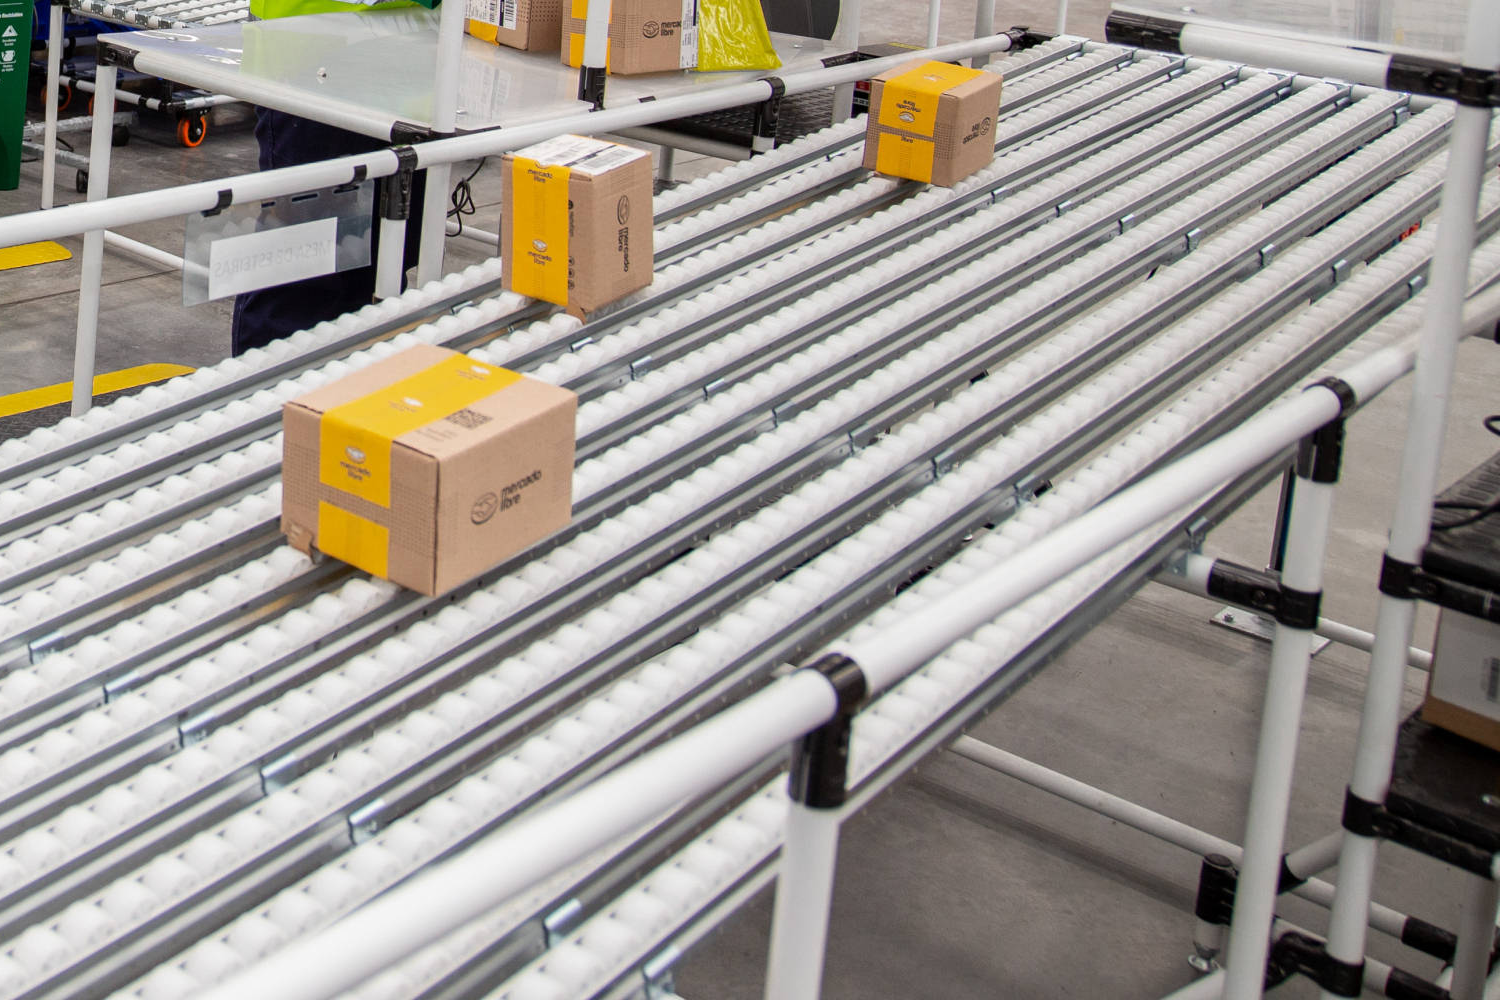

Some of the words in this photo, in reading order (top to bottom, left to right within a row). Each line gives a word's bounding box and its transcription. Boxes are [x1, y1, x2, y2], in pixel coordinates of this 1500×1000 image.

[621, 226, 629, 273] mercado
[340, 461, 372, 477] mercado
[500, 468, 543, 497] mercado
[499, 491, 521, 513] libre
